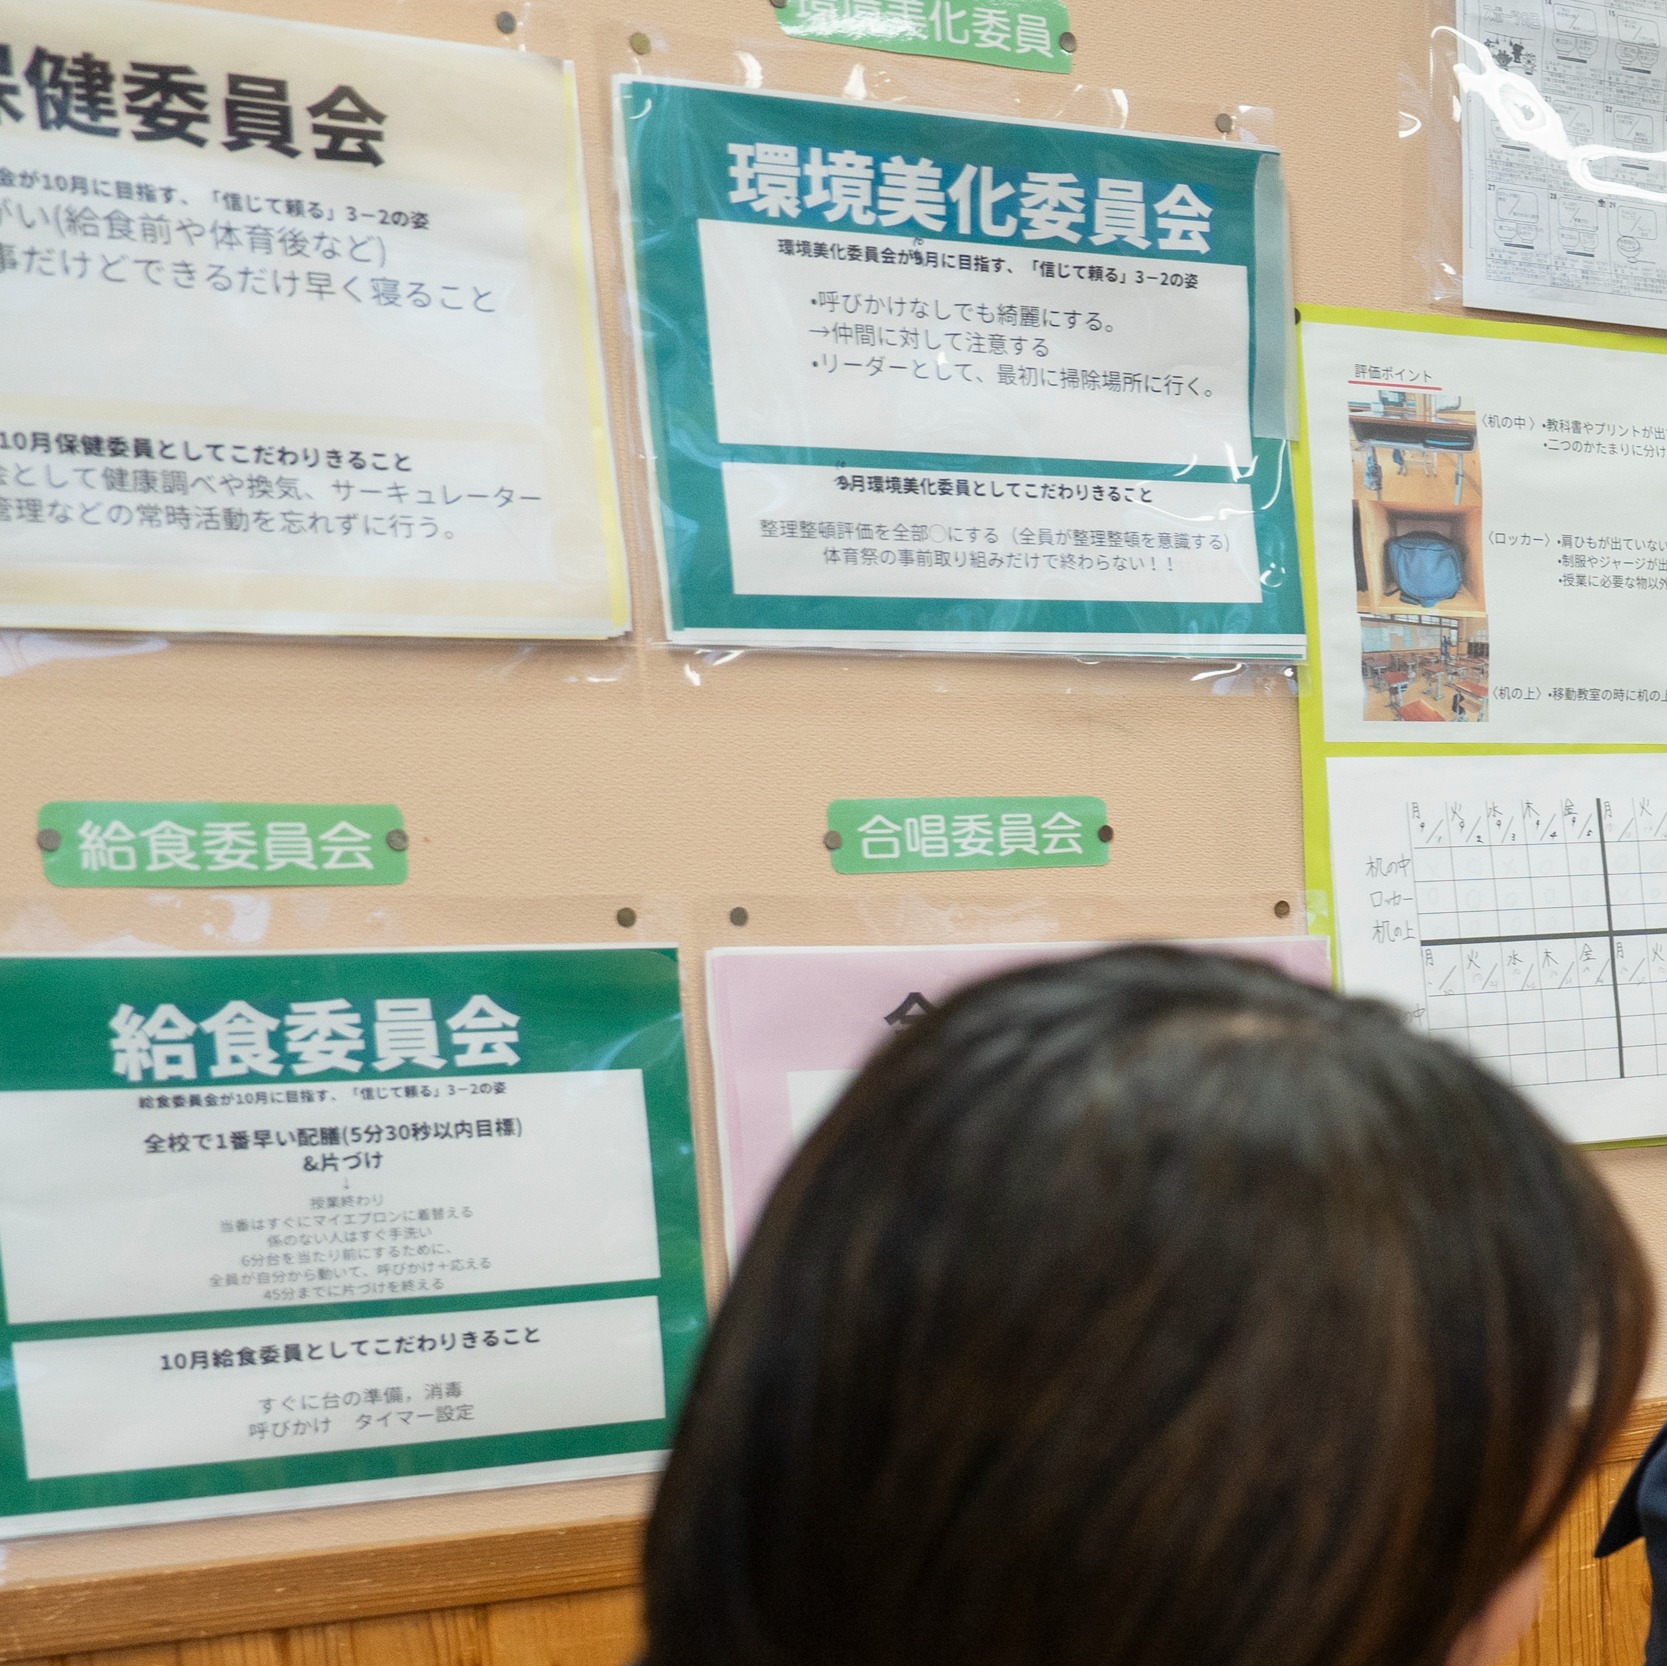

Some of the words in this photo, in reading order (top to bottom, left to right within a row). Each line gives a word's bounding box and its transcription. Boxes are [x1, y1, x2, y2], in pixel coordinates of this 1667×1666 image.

[727, 142, 1214, 255] 環境美化委員会
[1354, 363, 1433, 384] 評価ポイント
[0, 430, 414, 473] 10月保健委員としてこだわりきること
[0, 461, 543, 508] として健康調べや換気、サーキュレーター
[77, 820, 375, 872] 給食委員会
[857, 811, 1083, 859] 合唱委員会
[1366, 853, 1412, 878] 机の中
[1372, 919, 1417, 944] 机の上
[108, 994, 521, 1083] 給食委員会
[303, 1151, 383, 1173] &片づけ
[309, 1193, 384, 1210] 授業終わり
[160, 1326, 541, 1371] 10月給食委員としてこだわりきること
[249, 1416, 331, 1440] 呼びかけ
[355, 1403, 475, 1432] タイマー設定
